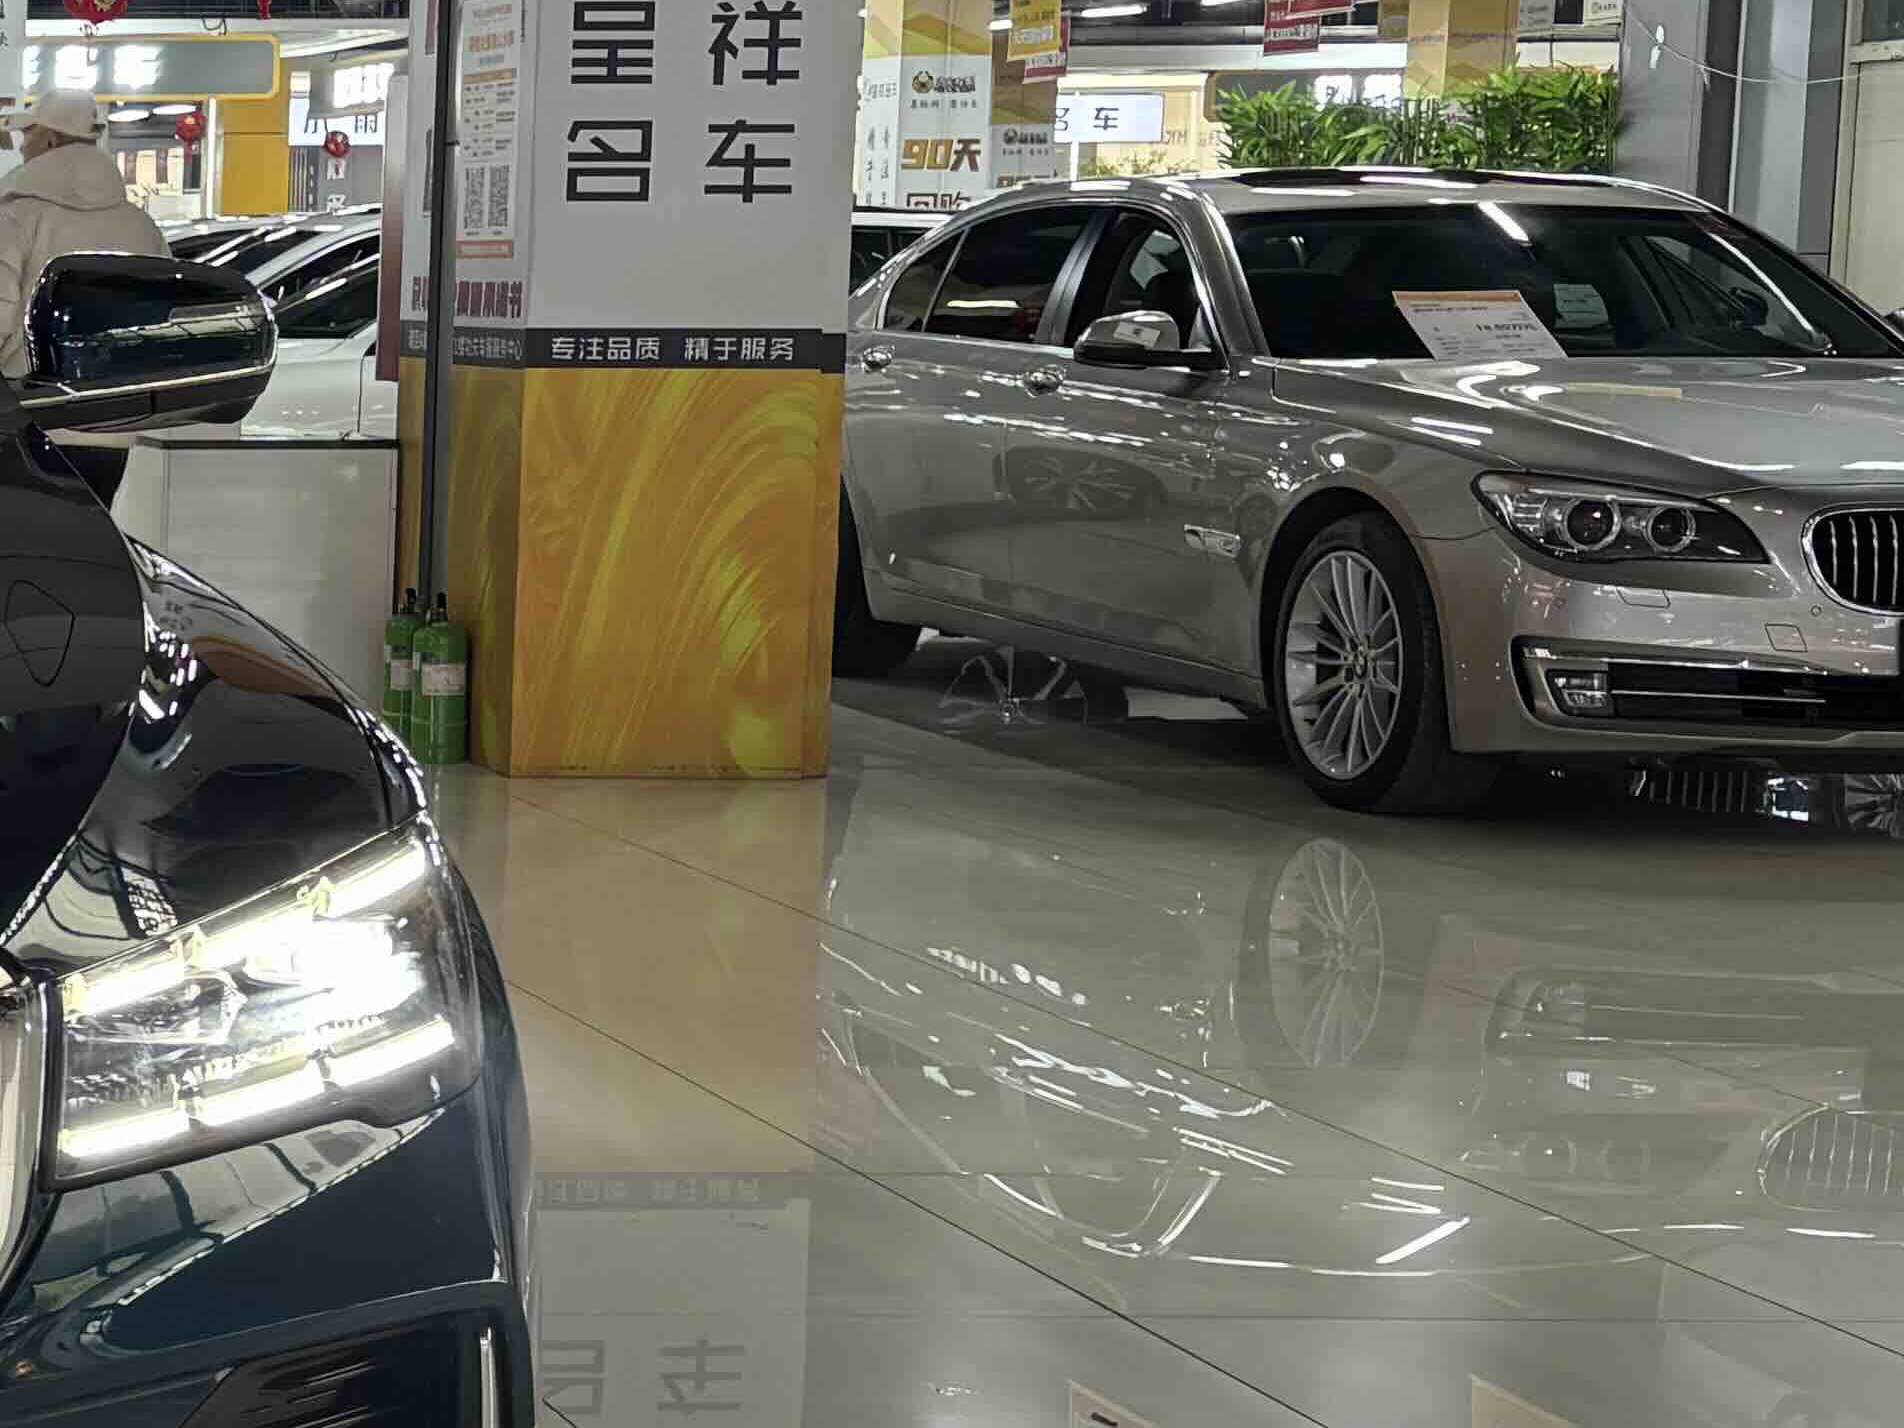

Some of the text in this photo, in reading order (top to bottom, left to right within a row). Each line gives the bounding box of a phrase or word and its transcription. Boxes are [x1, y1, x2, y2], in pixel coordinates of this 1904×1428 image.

[571, 1, 803, 86] 呈祥
[566, 119, 796, 203] 名车
[901, 138, 981, 172] 90天
[551, 336, 661, 363] 专注品质
[683, 336, 795, 363] 精于服务
